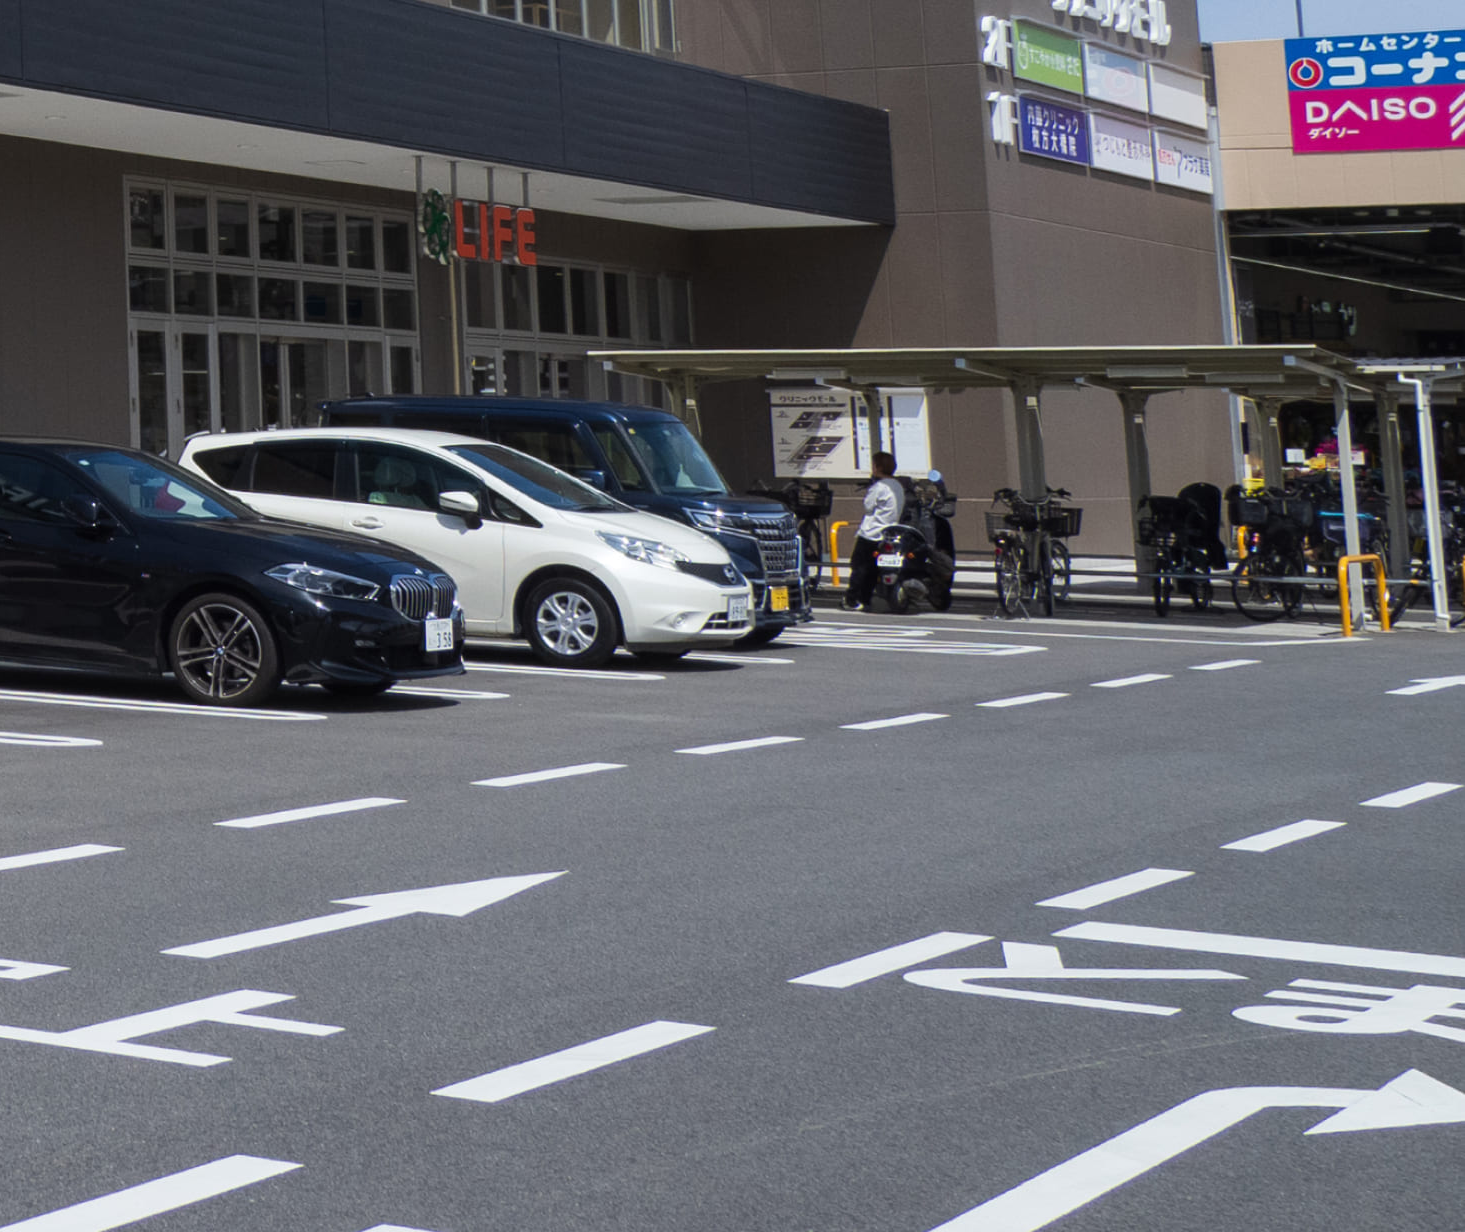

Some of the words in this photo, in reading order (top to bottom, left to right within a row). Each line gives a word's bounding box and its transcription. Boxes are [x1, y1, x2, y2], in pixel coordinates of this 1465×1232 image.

[1315, 33, 1462, 54] ホームセンター
[1305, 97, 1437, 123] DAISO
[1308, 127, 1360, 139] ダイソー
[454, 199, 537, 266] LIFE
